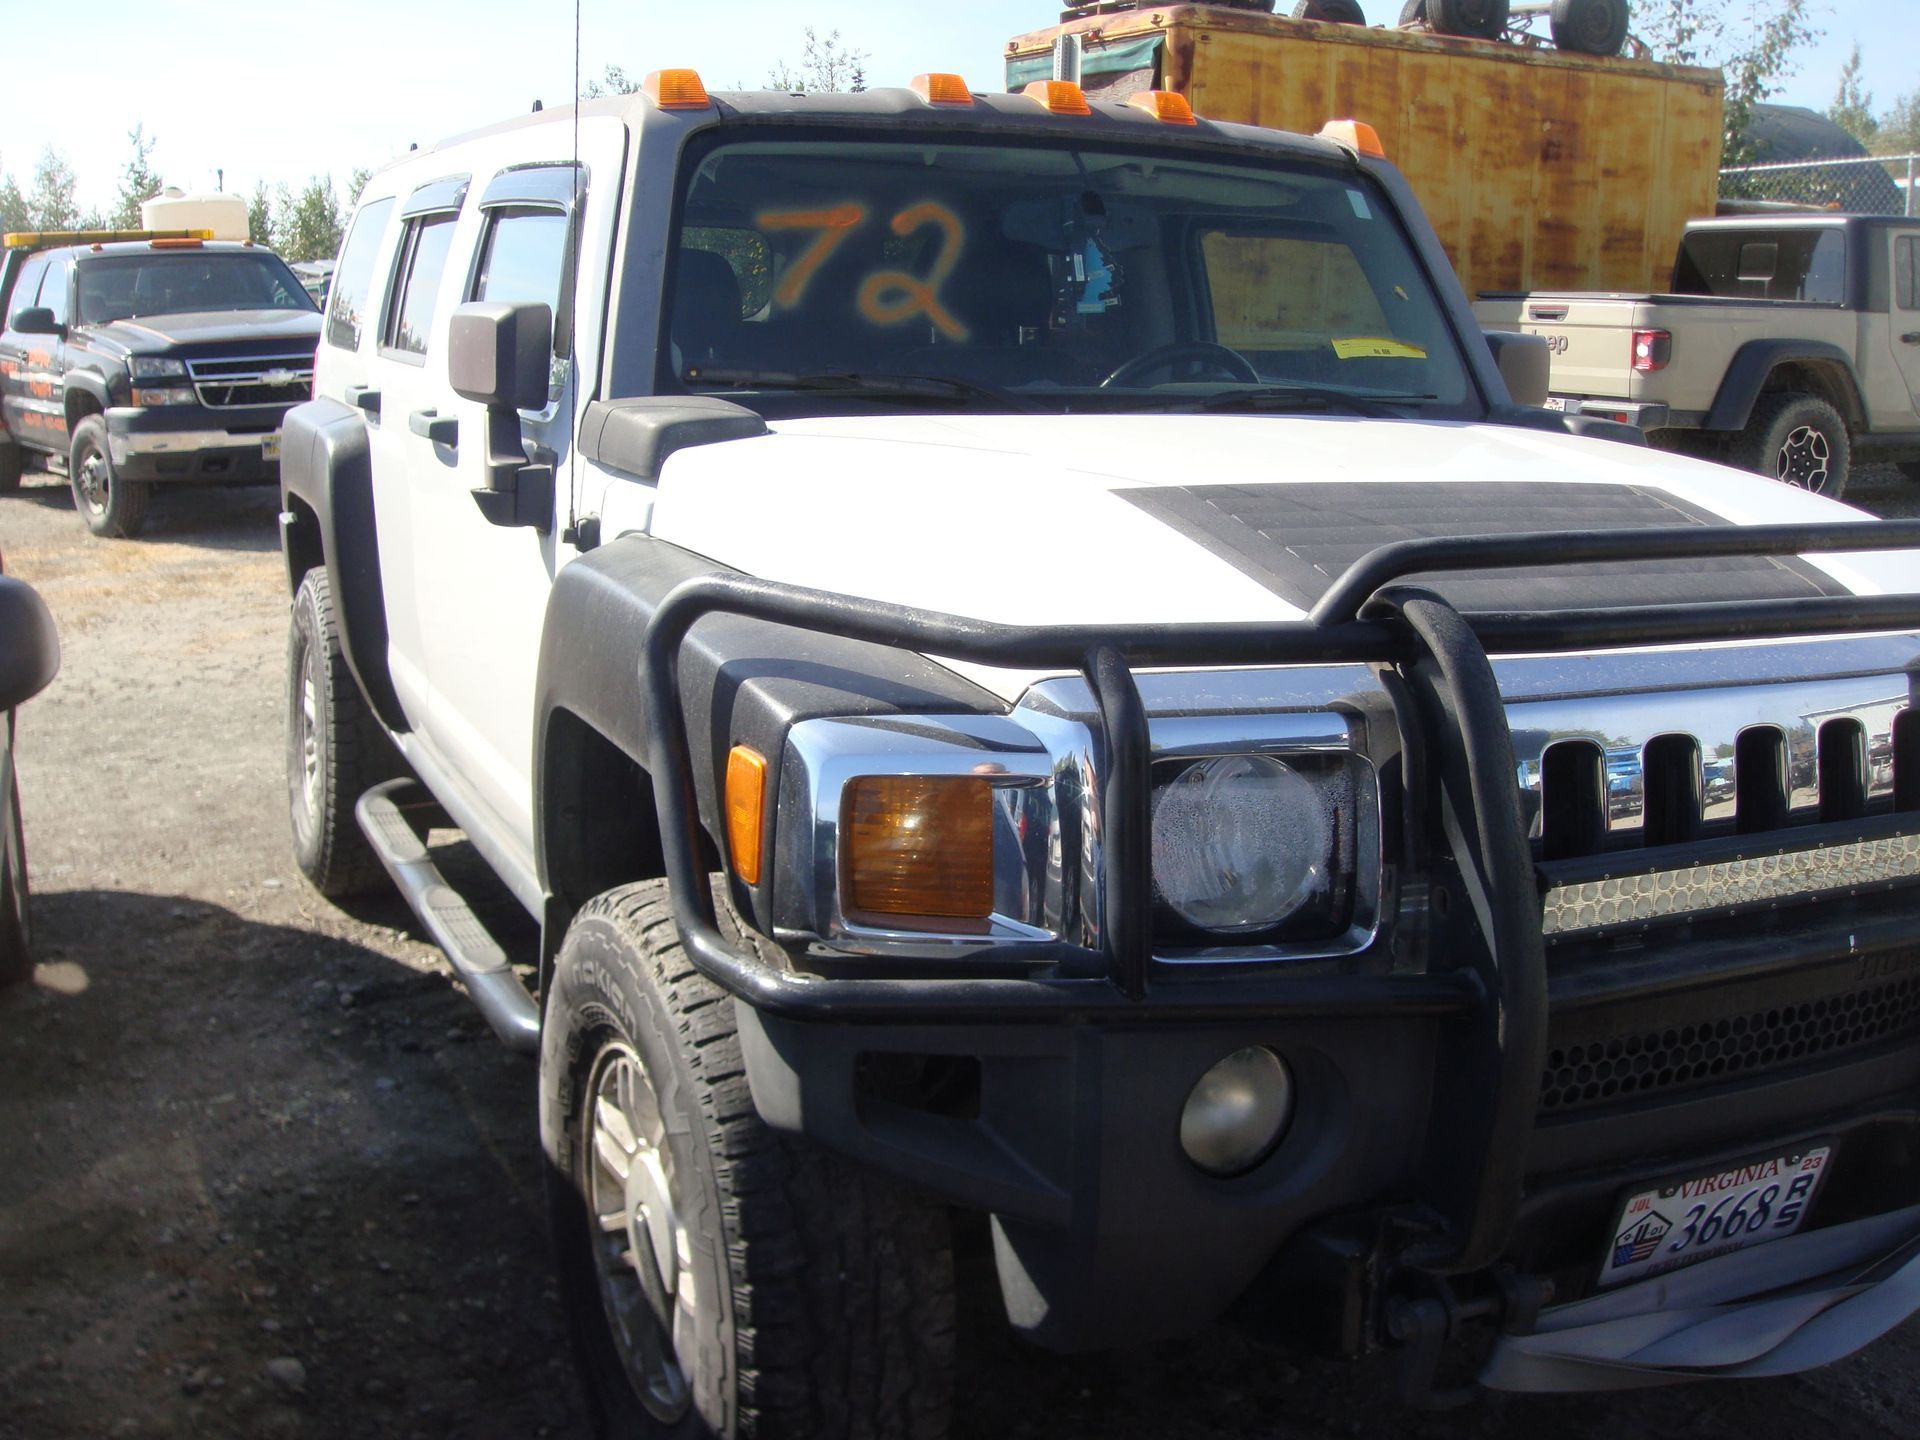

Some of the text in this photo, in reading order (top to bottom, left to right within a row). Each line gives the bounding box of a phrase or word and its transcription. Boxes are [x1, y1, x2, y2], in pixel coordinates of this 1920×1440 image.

[757, 202, 968, 342] 72
[1680, 1158, 1779, 1200] VIRGINIA
[1801, 1156, 1823, 1171] 23
[1670, 1184, 1780, 1251] 3668
